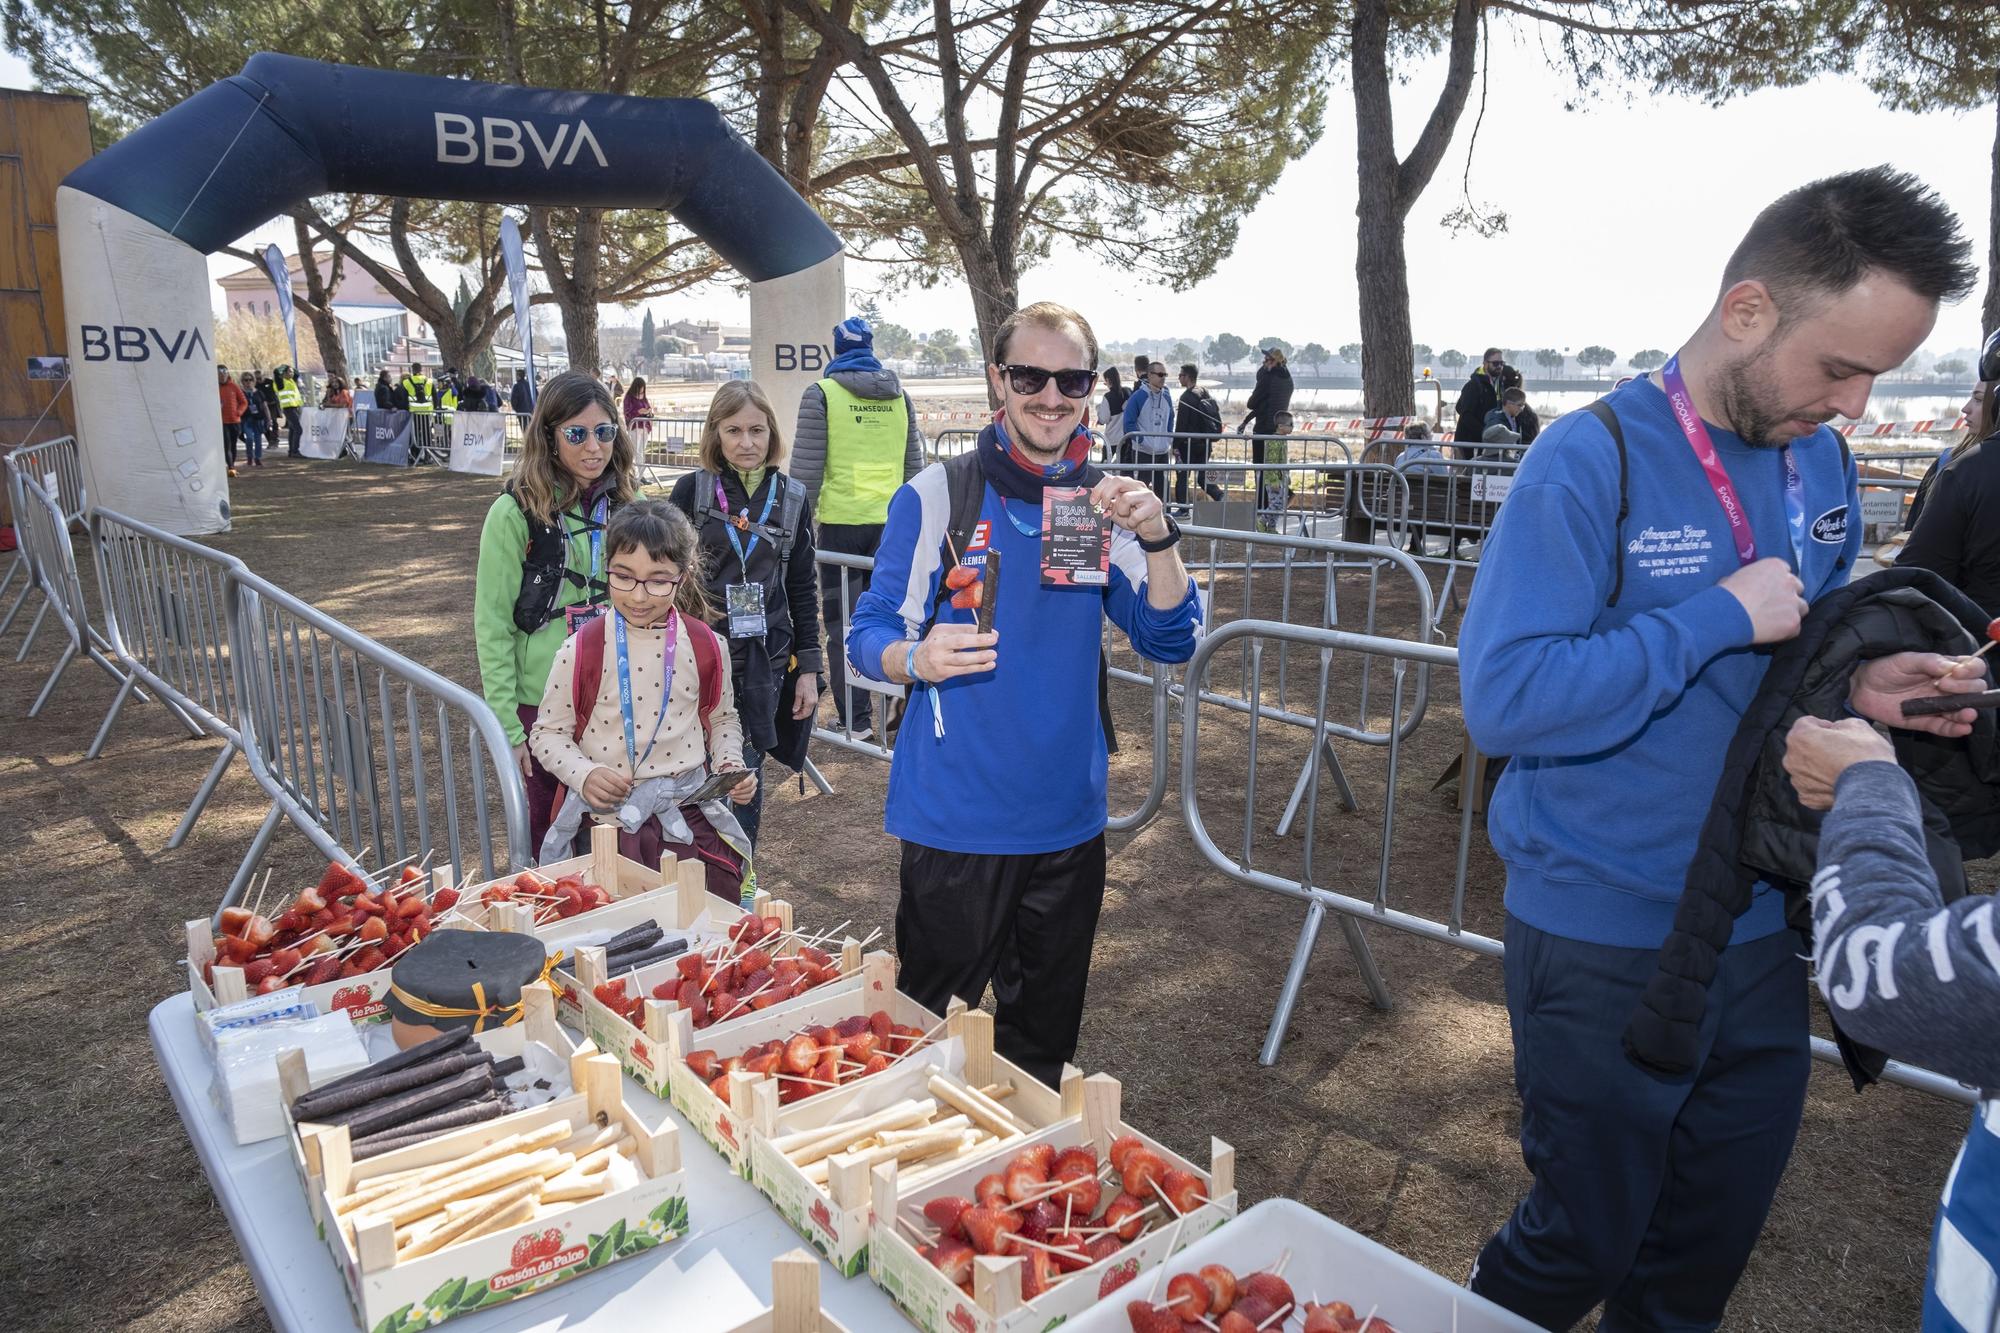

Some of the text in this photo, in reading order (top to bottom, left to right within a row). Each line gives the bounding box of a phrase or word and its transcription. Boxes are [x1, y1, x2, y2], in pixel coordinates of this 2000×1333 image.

[434, 112, 609, 170] BBVA
[81, 325, 210, 363] BBVA
[775, 344, 833, 371] BB
[311, 425, 330, 437] BBVA
[375, 426, 395, 440] BBVA
[463, 433, 484, 446] BBVA
[352, 1007, 364, 1018] de
[494, 1267, 538, 1290] Fresón
[538, 1260, 553, 1274] de
[553, 1249, 585, 1269] Palos
